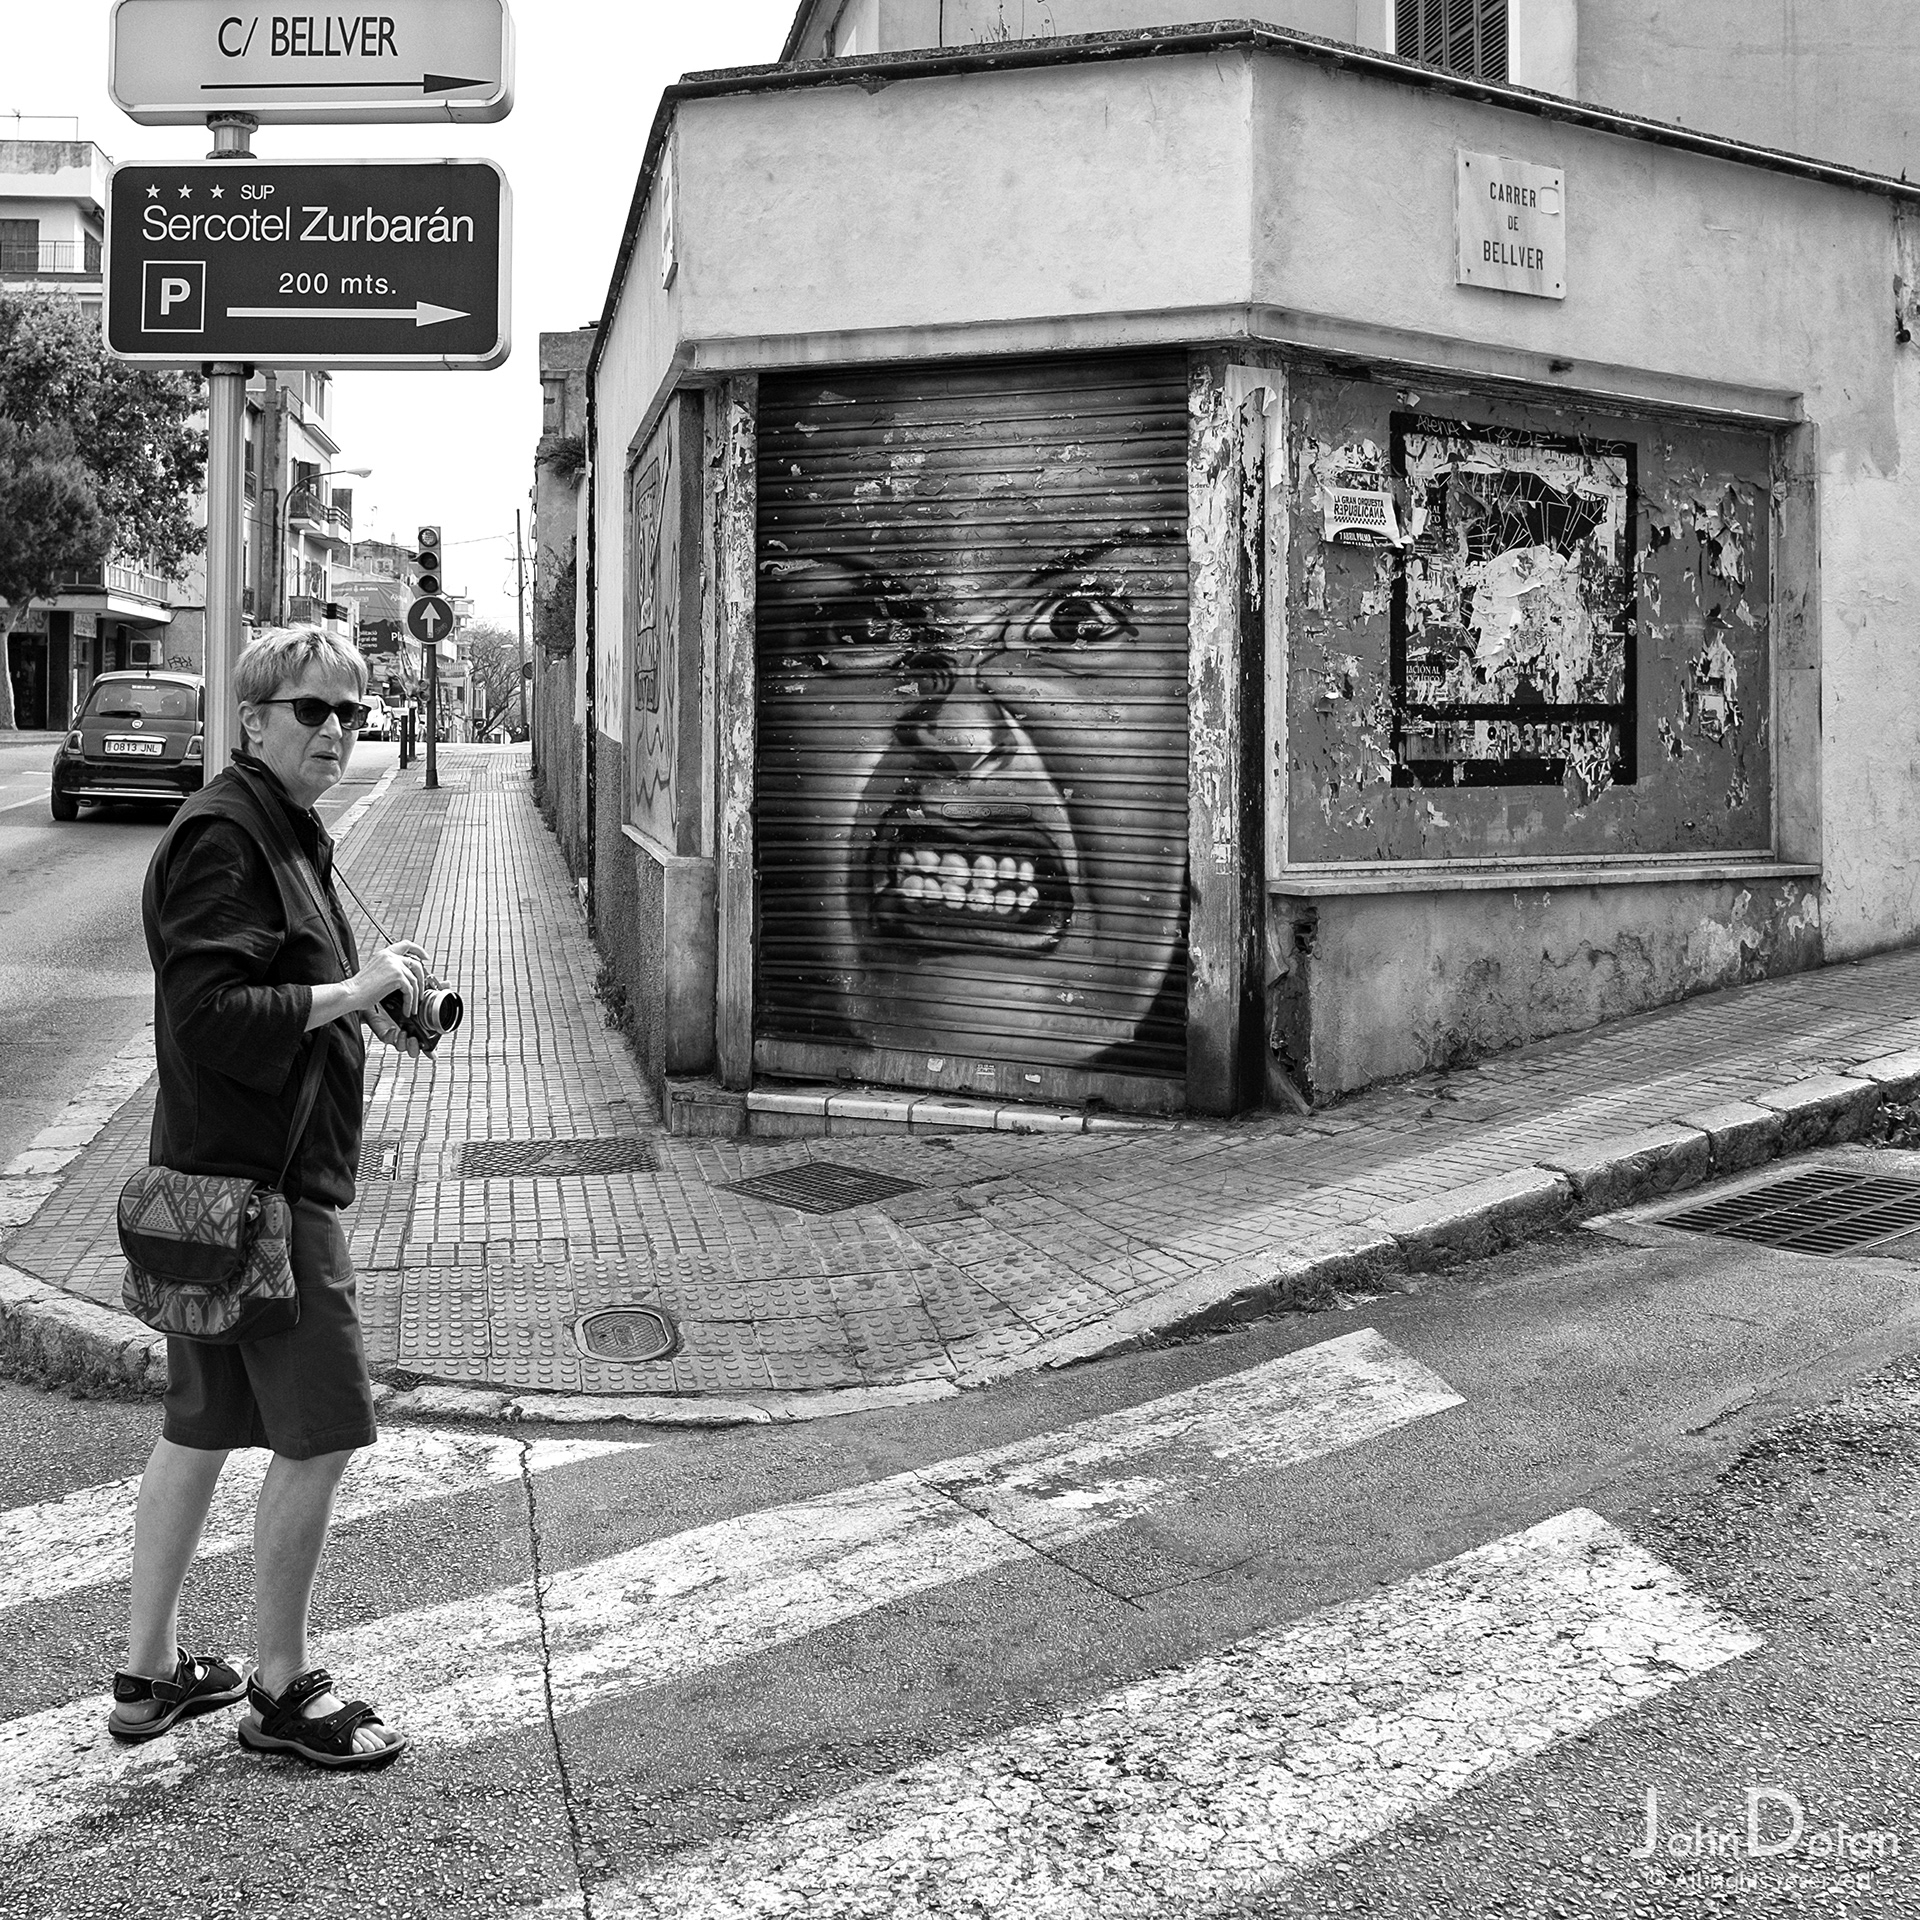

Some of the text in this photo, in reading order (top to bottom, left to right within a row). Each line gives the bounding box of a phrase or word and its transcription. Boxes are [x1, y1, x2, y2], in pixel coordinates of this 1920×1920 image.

[218, 16, 399, 57] C/ BELLVER
[240, 184, 275, 200] SUP
[1490, 182, 1536, 208] CARRER
[142, 204, 474, 243] Sercotel Zurbarán
[1508, 215, 1519, 231] DE
[1483, 240, 1544, 271] BELLVER
[278, 273, 398, 295] 200 mts.
[160, 277, 191, 316] P
[1341, 495, 1357, 505] GRAN
[1358, 497, 1384, 508] ORQUESTA
[113, 742, 158, 753] 0813 JNL
